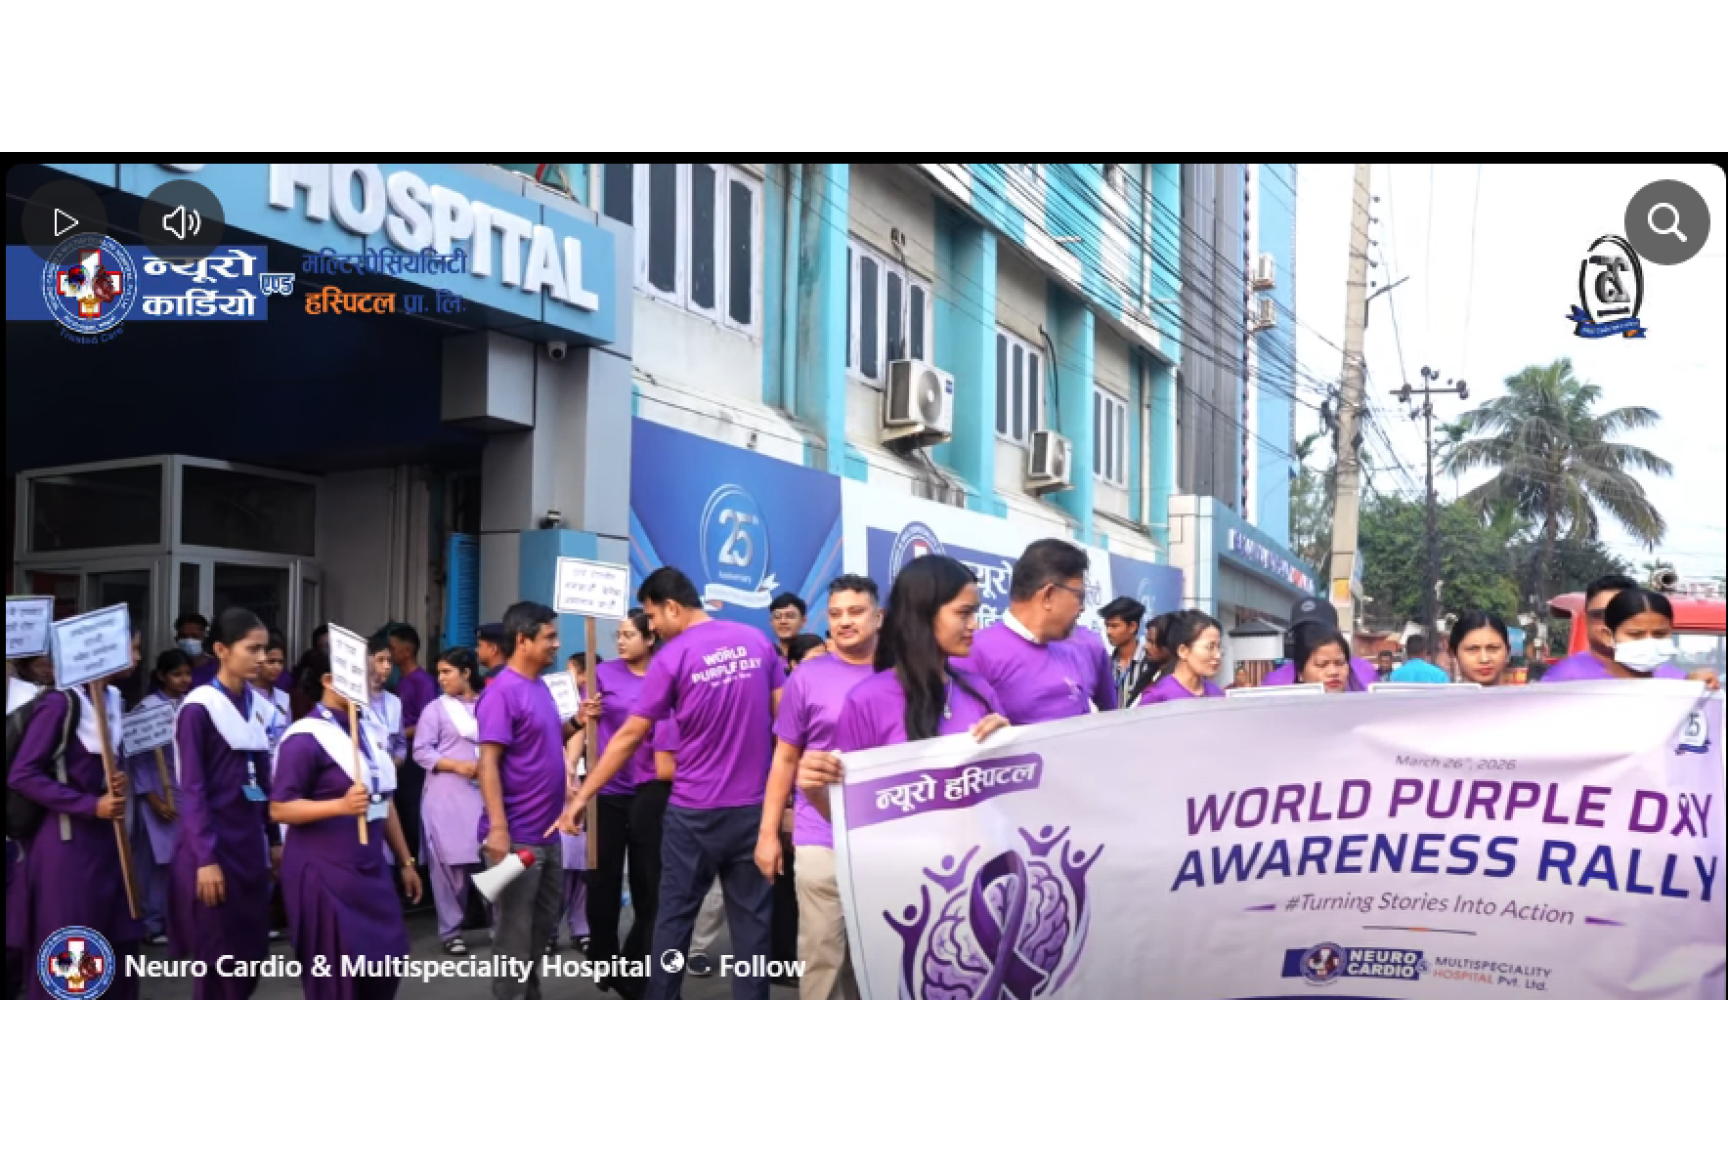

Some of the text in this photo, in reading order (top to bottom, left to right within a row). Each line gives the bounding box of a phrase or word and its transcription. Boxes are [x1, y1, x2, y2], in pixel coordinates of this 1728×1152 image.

[269, 164, 598, 312] HOSPITAL
[702, 645, 747, 666] WORLD
[1395, 755, 1441, 769] March
[1477, 758, 1517, 771] 2026
[875, 762, 1038, 812] न्यूरो हस्पिटल
[1187, 778, 1713, 839] WORLD PURPLE DAY
[1169, 833, 1718, 902] AWARENESS RALLY
[1285, 892, 1575, 925] #Turning Stories Into Action
[1350, 950, 1417, 964] NEURO
[1434, 956, 1553, 978] MULTISPECIALITY
[1347, 963, 1415, 977] CARDIO
[1432, 968, 1494, 985] HOSPITAL
[1524, 979, 1549, 991] Ltd.
